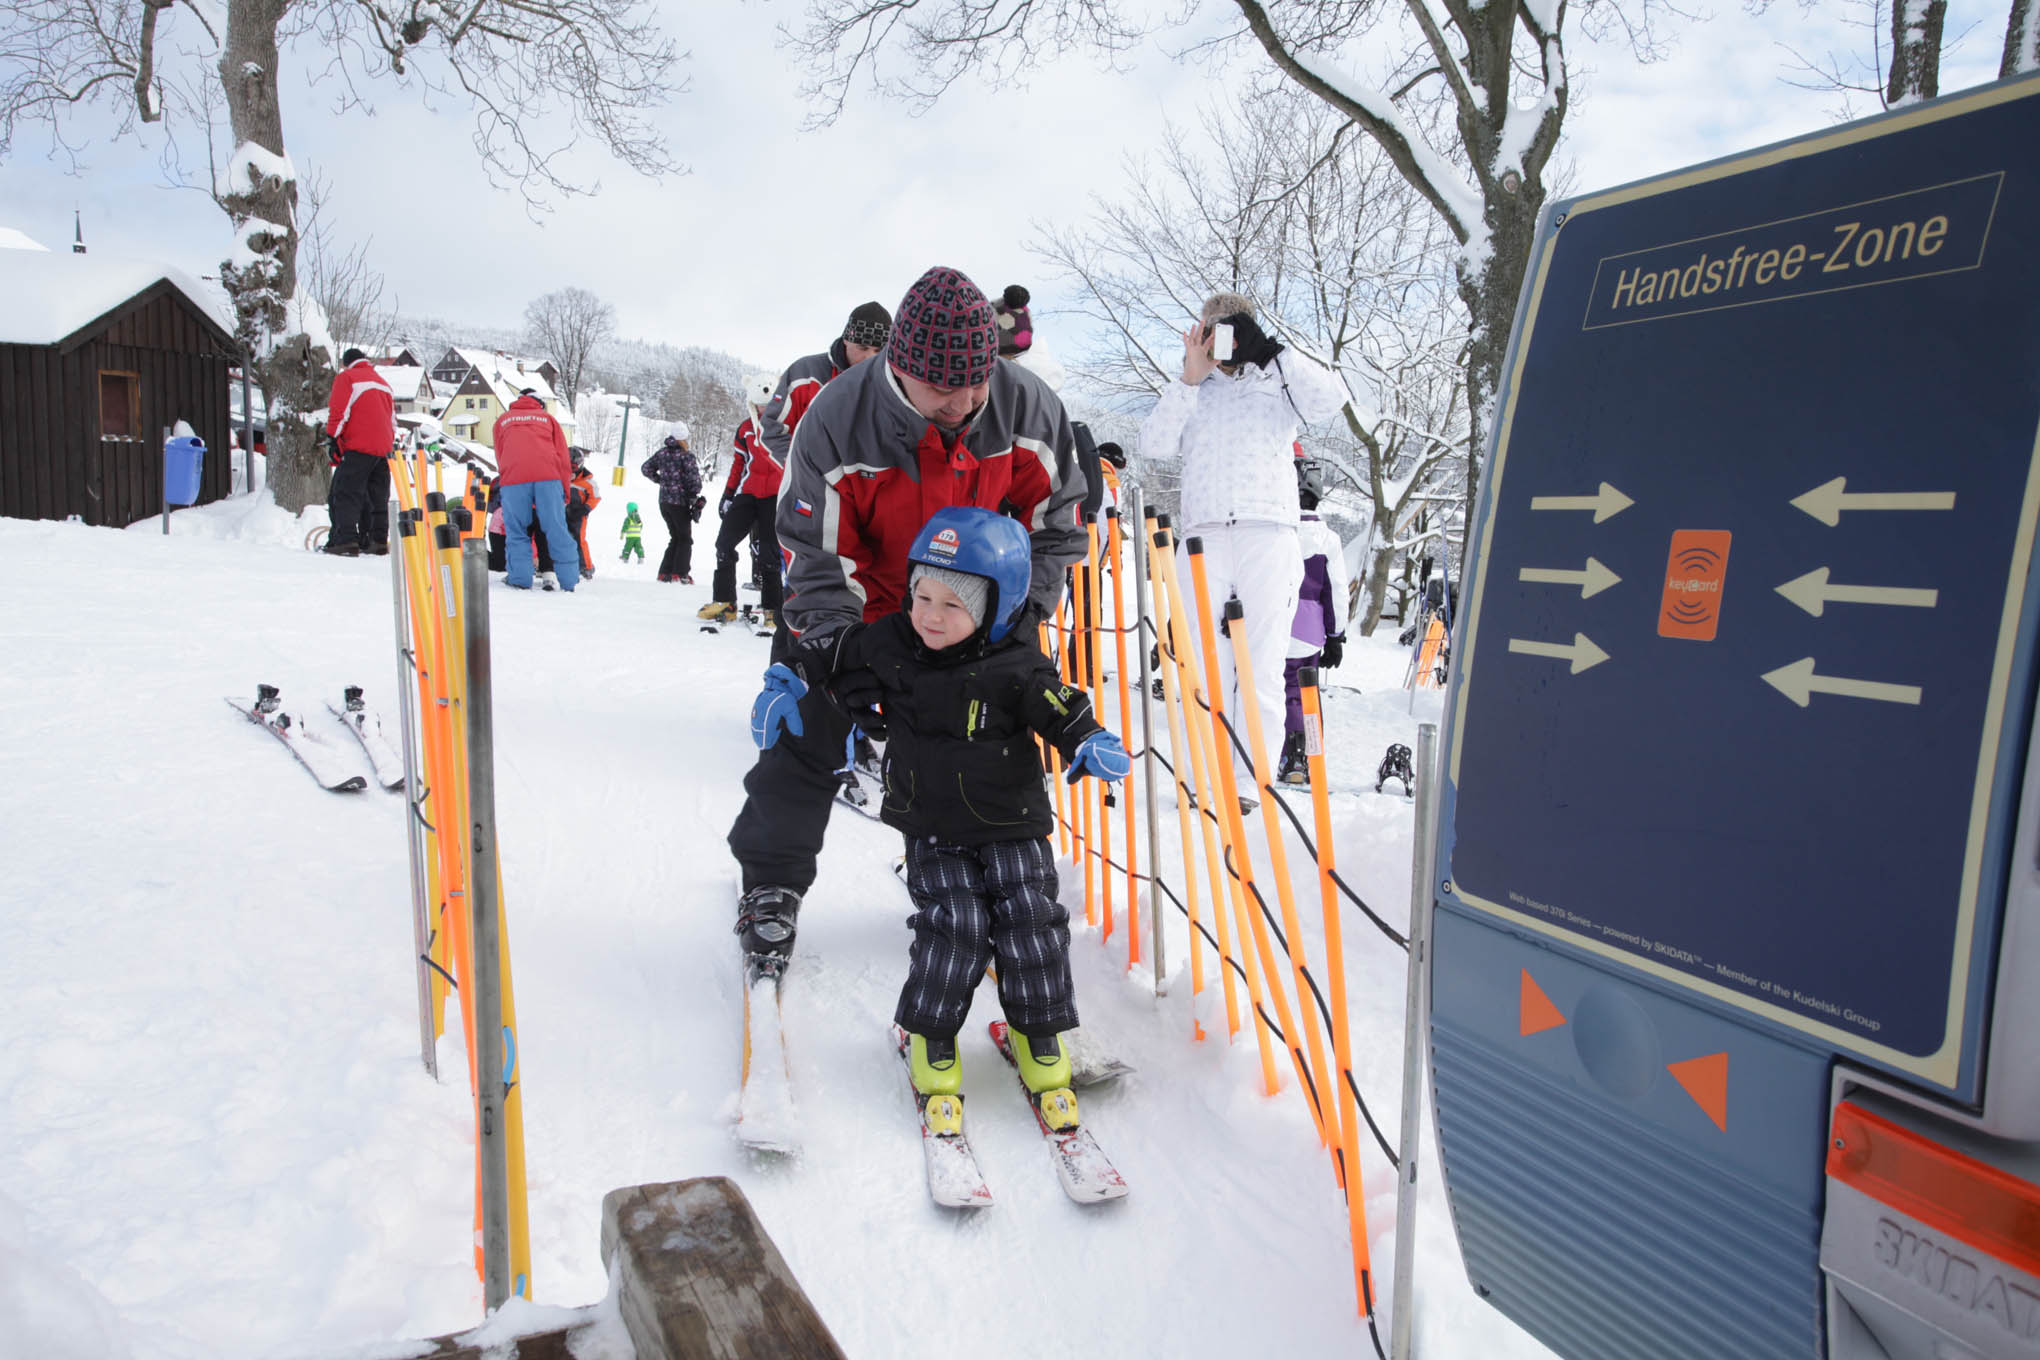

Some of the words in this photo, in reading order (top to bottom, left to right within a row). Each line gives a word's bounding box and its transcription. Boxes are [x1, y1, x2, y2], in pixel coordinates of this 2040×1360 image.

[1611, 214, 1949, 310] Handsfree-Zone
[1509, 889, 1526, 905] Web
[1526, 898, 1549, 913] based
[1567, 911, 1591, 928] Series
[1603, 926, 1640, 945] powered
[1641, 937, 1653, 952] by
[1716, 963, 1758, 988] Member
[1760, 981, 1772, 992] of
[1773, 984, 1791, 999] the
[1793, 991, 1841, 1017] Kudelski
[1843, 1008, 1881, 1032] Group
